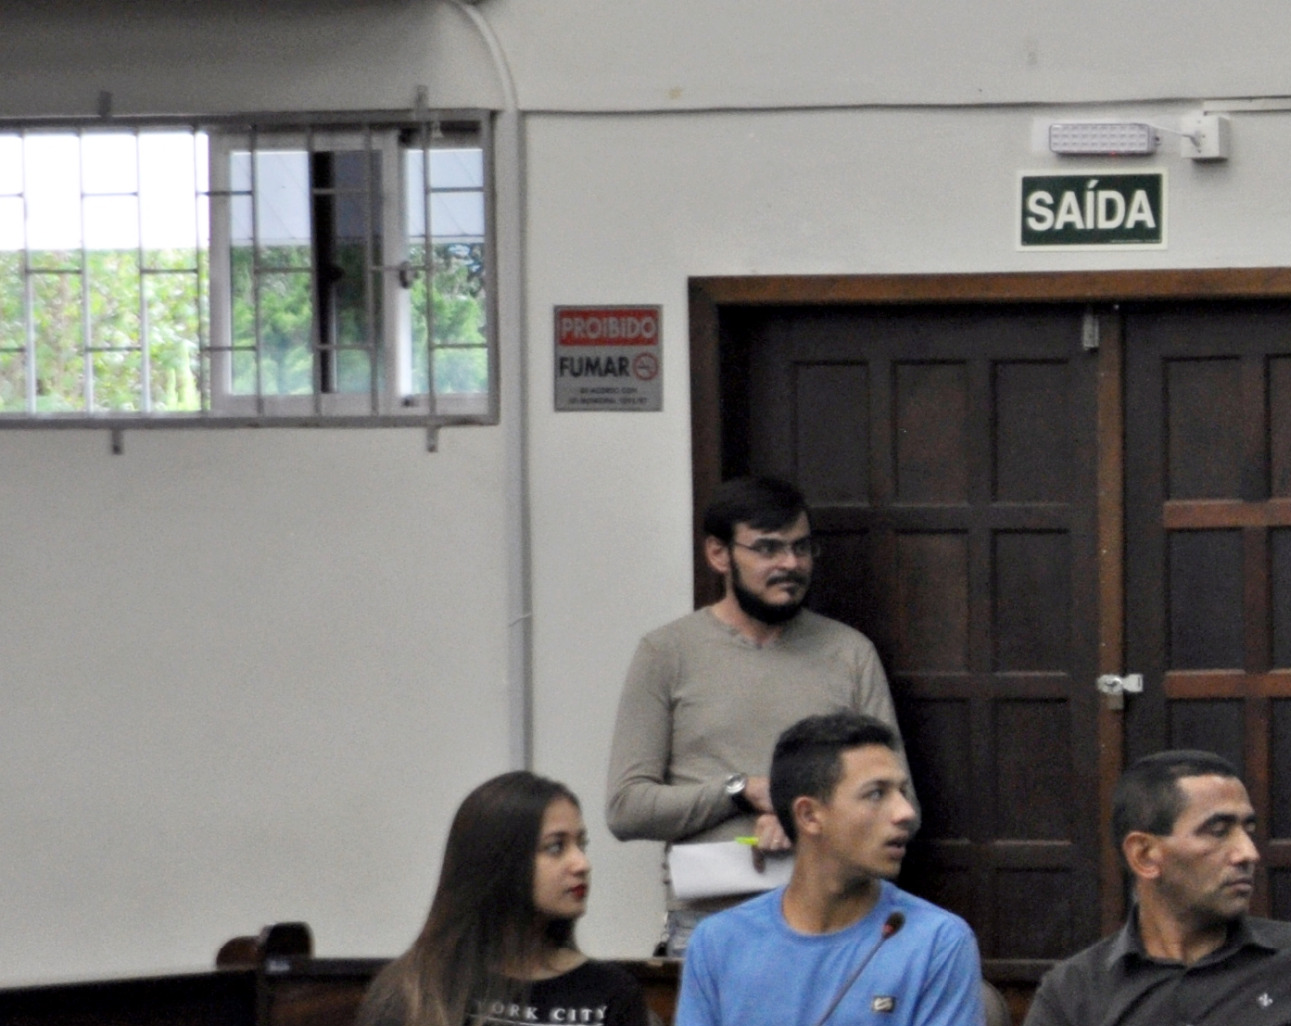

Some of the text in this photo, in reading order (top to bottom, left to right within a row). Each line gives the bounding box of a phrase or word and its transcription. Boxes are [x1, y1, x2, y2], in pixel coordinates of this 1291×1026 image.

[1027, 179, 1156, 231] SAÍDA
[561, 317, 656, 339] PROIBIDO
[560, 356, 630, 378] FUMAR
[552, 1005, 608, 1022] CITY
